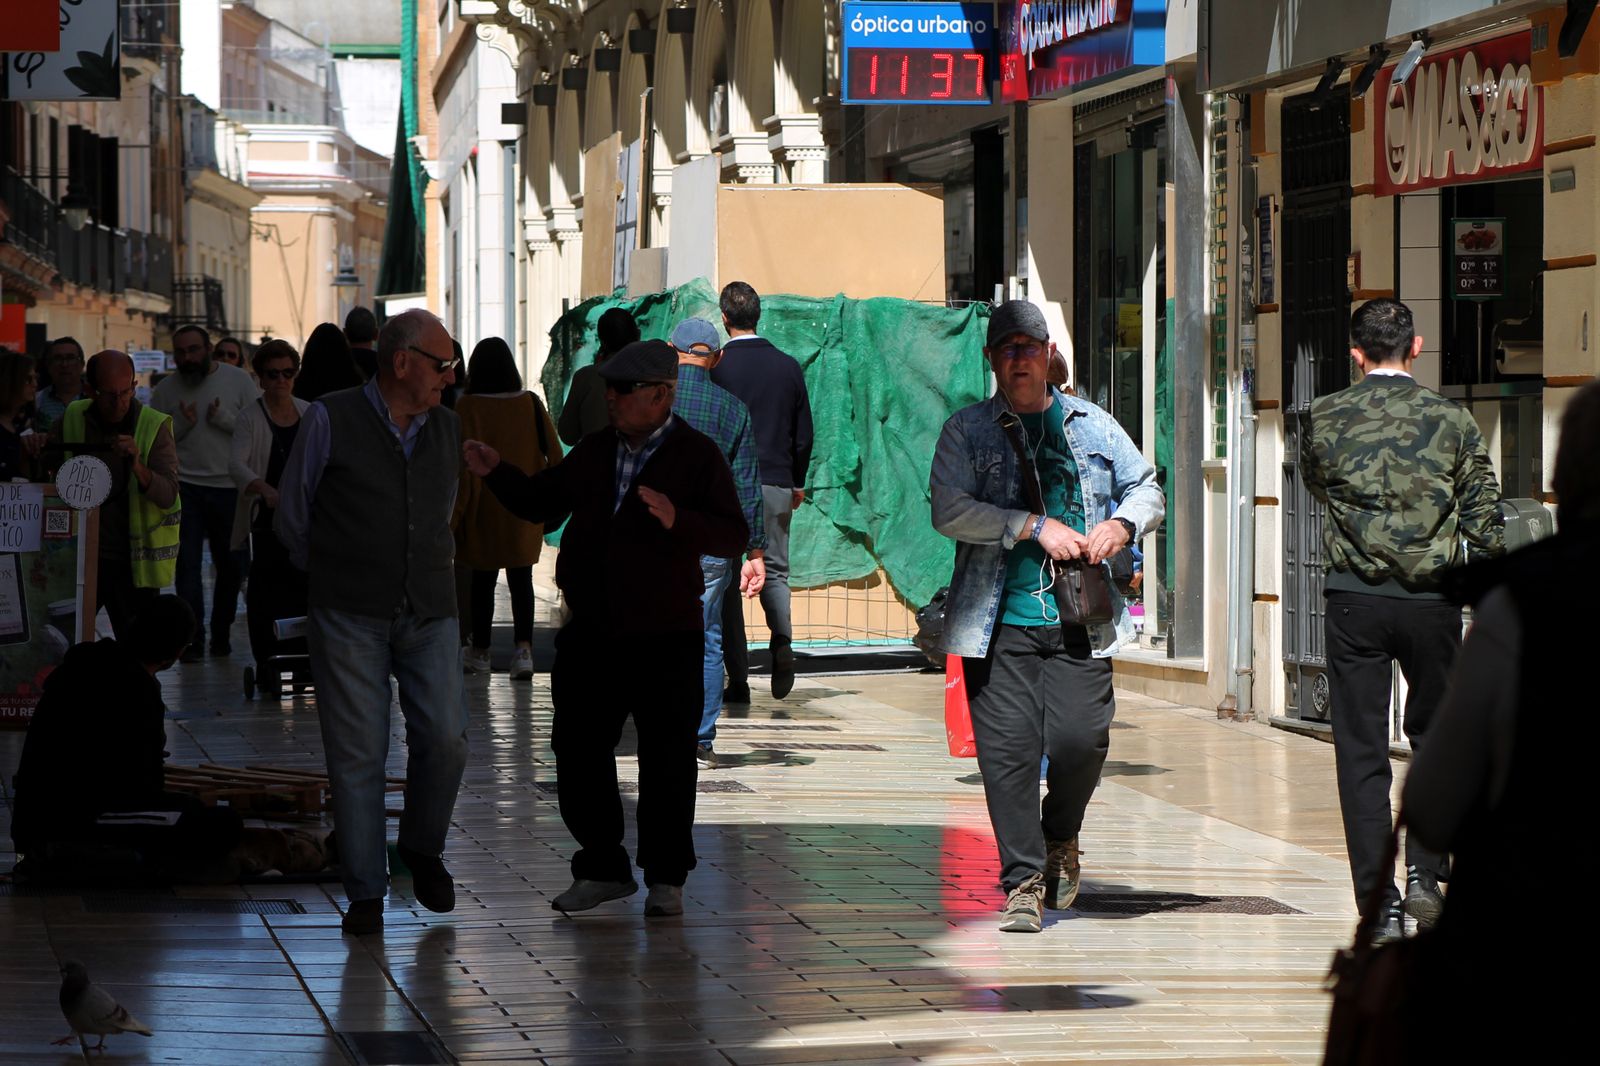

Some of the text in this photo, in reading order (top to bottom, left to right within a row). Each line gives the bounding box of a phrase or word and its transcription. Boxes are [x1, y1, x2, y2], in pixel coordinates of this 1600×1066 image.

[850, 12, 987, 37] óptica urbano
[10, 485, 23, 501] DE
